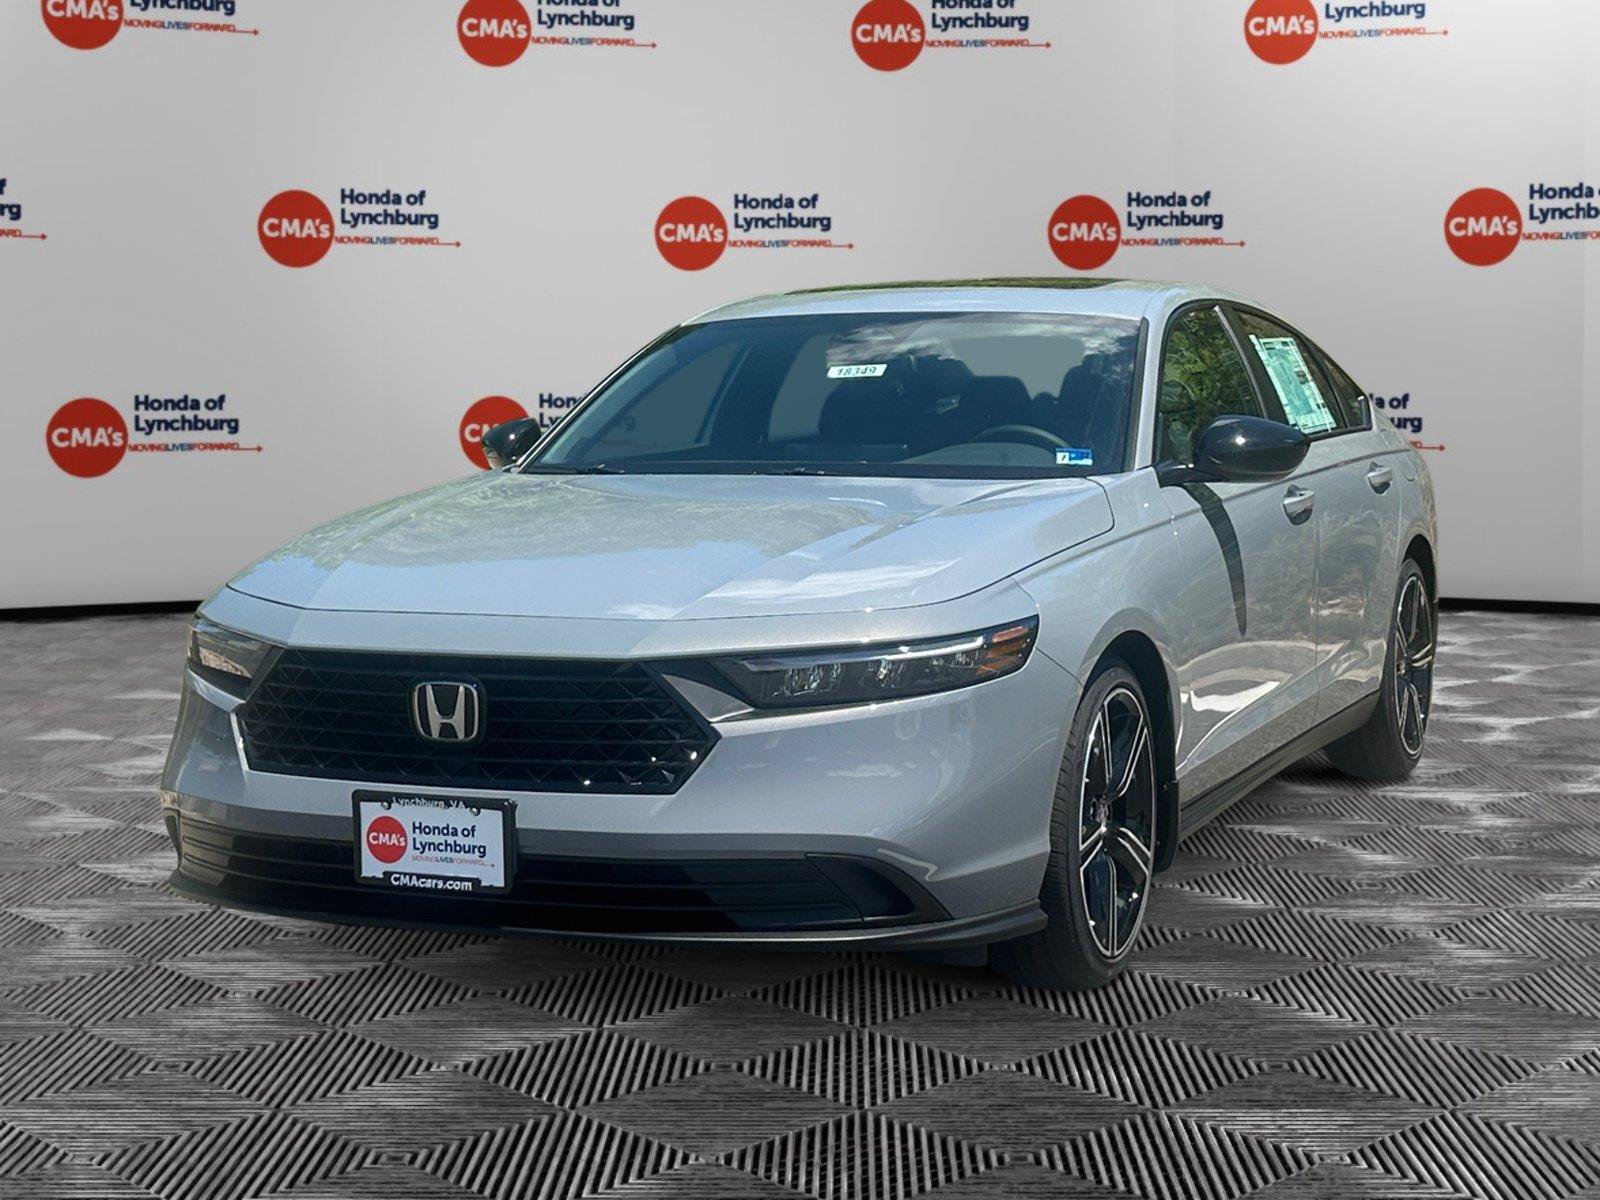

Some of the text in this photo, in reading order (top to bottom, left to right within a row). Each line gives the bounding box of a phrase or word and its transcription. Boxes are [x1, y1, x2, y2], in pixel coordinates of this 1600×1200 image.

[46, 0, 119, 21] CMA's
[537, 9, 635, 30] Lynchburg
[1325, 1, 1426, 22] Lynchburg
[462, 17, 528, 39] CMA's
[931, 13, 1029, 31] Lynchburg
[1249, 15, 1315, 36] CMA's
[855, 23, 922, 43] CMA's
[340, 188, 426, 206] Honda of
[1127, 191, 1211, 208] Honda of
[1529, 182, 1594, 200] Honda
[733, 193, 819, 210] Honda of
[262, 217, 330, 238] CMA's
[340, 208, 439, 229] Lynchburg
[733, 213, 832, 233] Lynchburg
[1126, 210, 1224, 231] Lynchburg
[1450, 215, 1518, 237] CMA's
[658, 223, 724, 243] CMA's
[1052, 222, 1118, 243] CMA's
[134, 394, 226, 411] Honda of
[1389, 393, 1410, 409] of
[134, 414, 239, 435] Lynchburg
[52, 427, 123, 448] CMA's
[368, 832, 406, 847] CMA's
[412, 821, 477, 838] Honda of
[412, 837, 487, 859] Lynchburg
[390, 873, 473, 892] CMAcars.com
